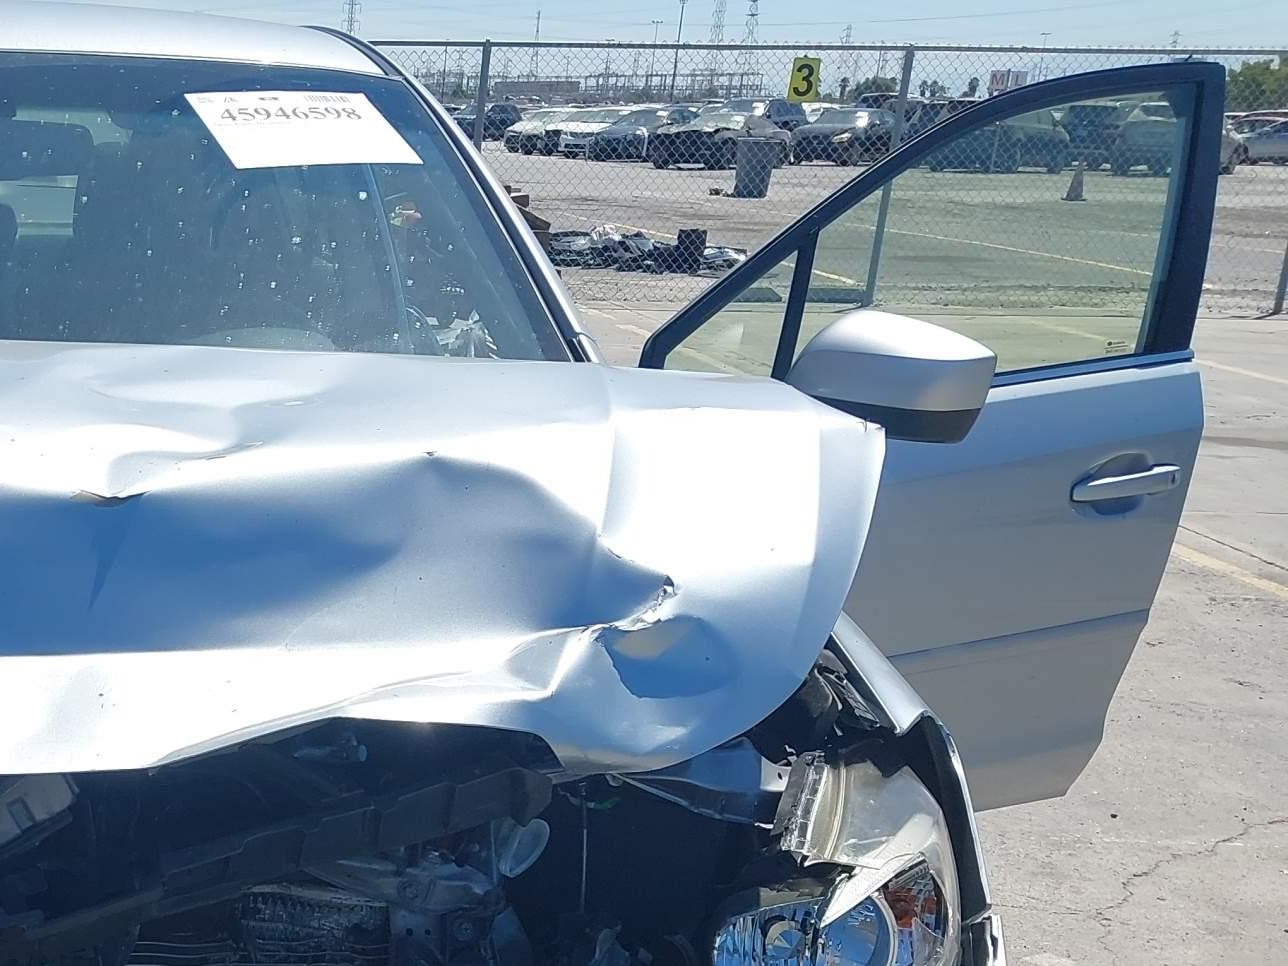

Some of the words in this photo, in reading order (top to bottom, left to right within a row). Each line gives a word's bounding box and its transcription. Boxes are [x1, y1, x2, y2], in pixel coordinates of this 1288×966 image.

[792, 63, 815, 97] 3
[991, 72, 1006, 87] M
[220, 106, 363, 121] 45946598
